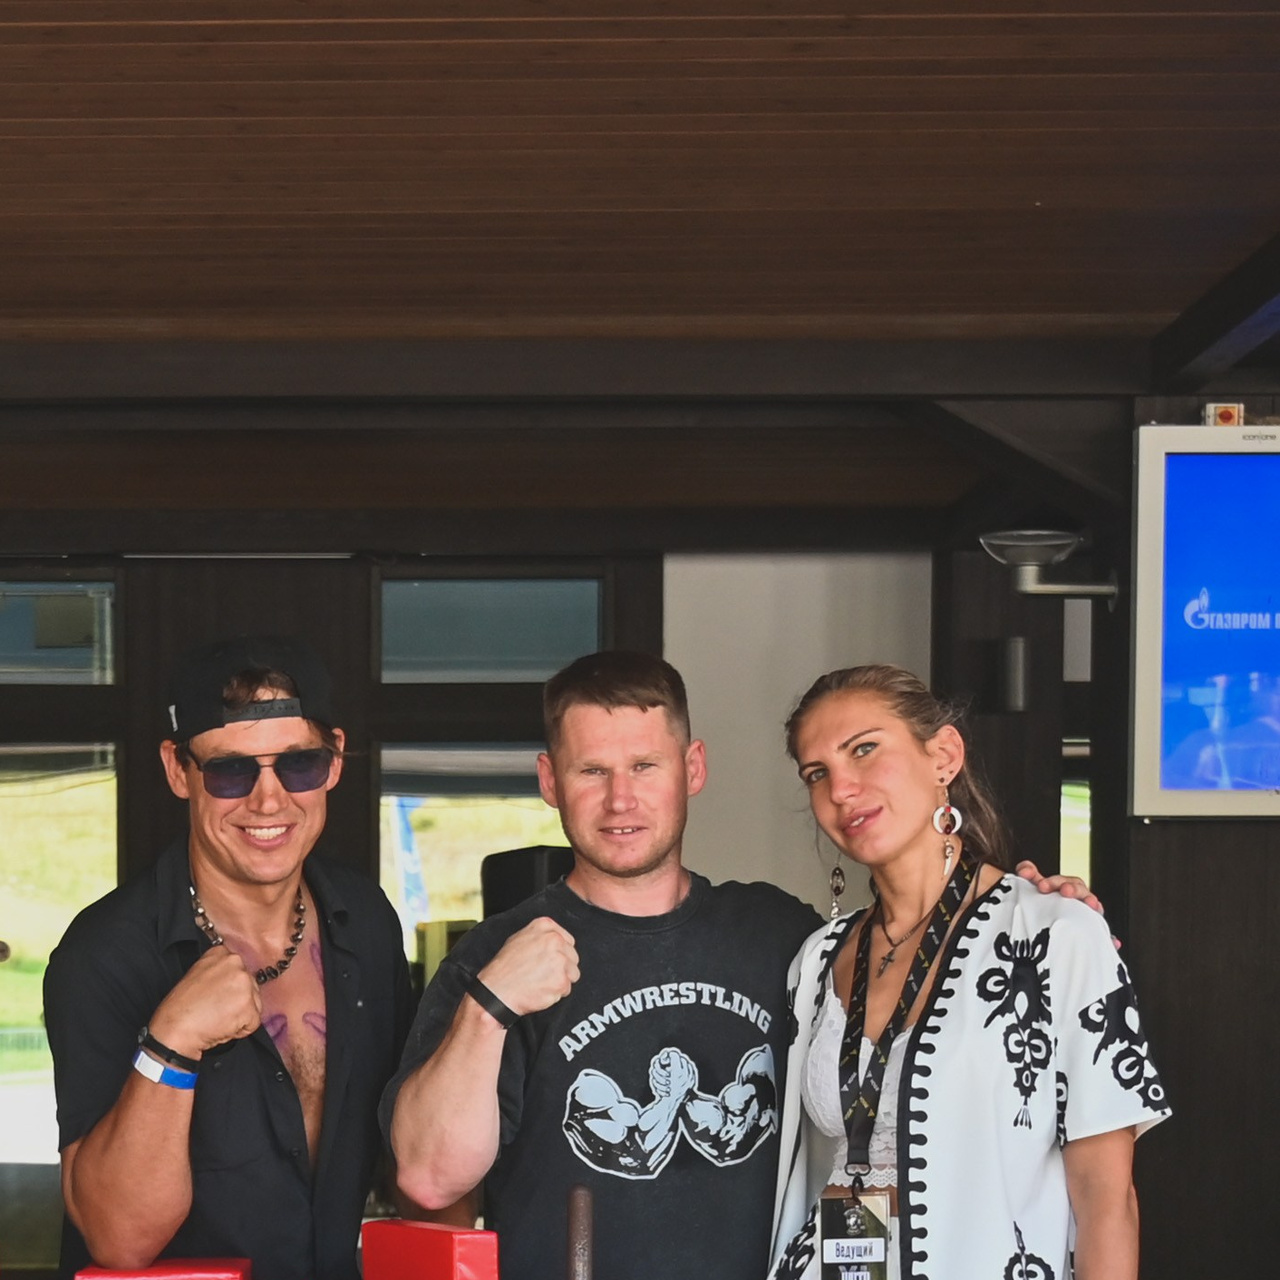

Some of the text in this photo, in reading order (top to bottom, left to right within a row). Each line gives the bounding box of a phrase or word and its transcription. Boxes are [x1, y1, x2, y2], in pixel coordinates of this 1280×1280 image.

[1209, 612, 1271, 630] ГАЗПРОМ
[558, 982, 772, 1062] ARMWRESTLING
[835, 1241, 874, 1260] Ведущий
